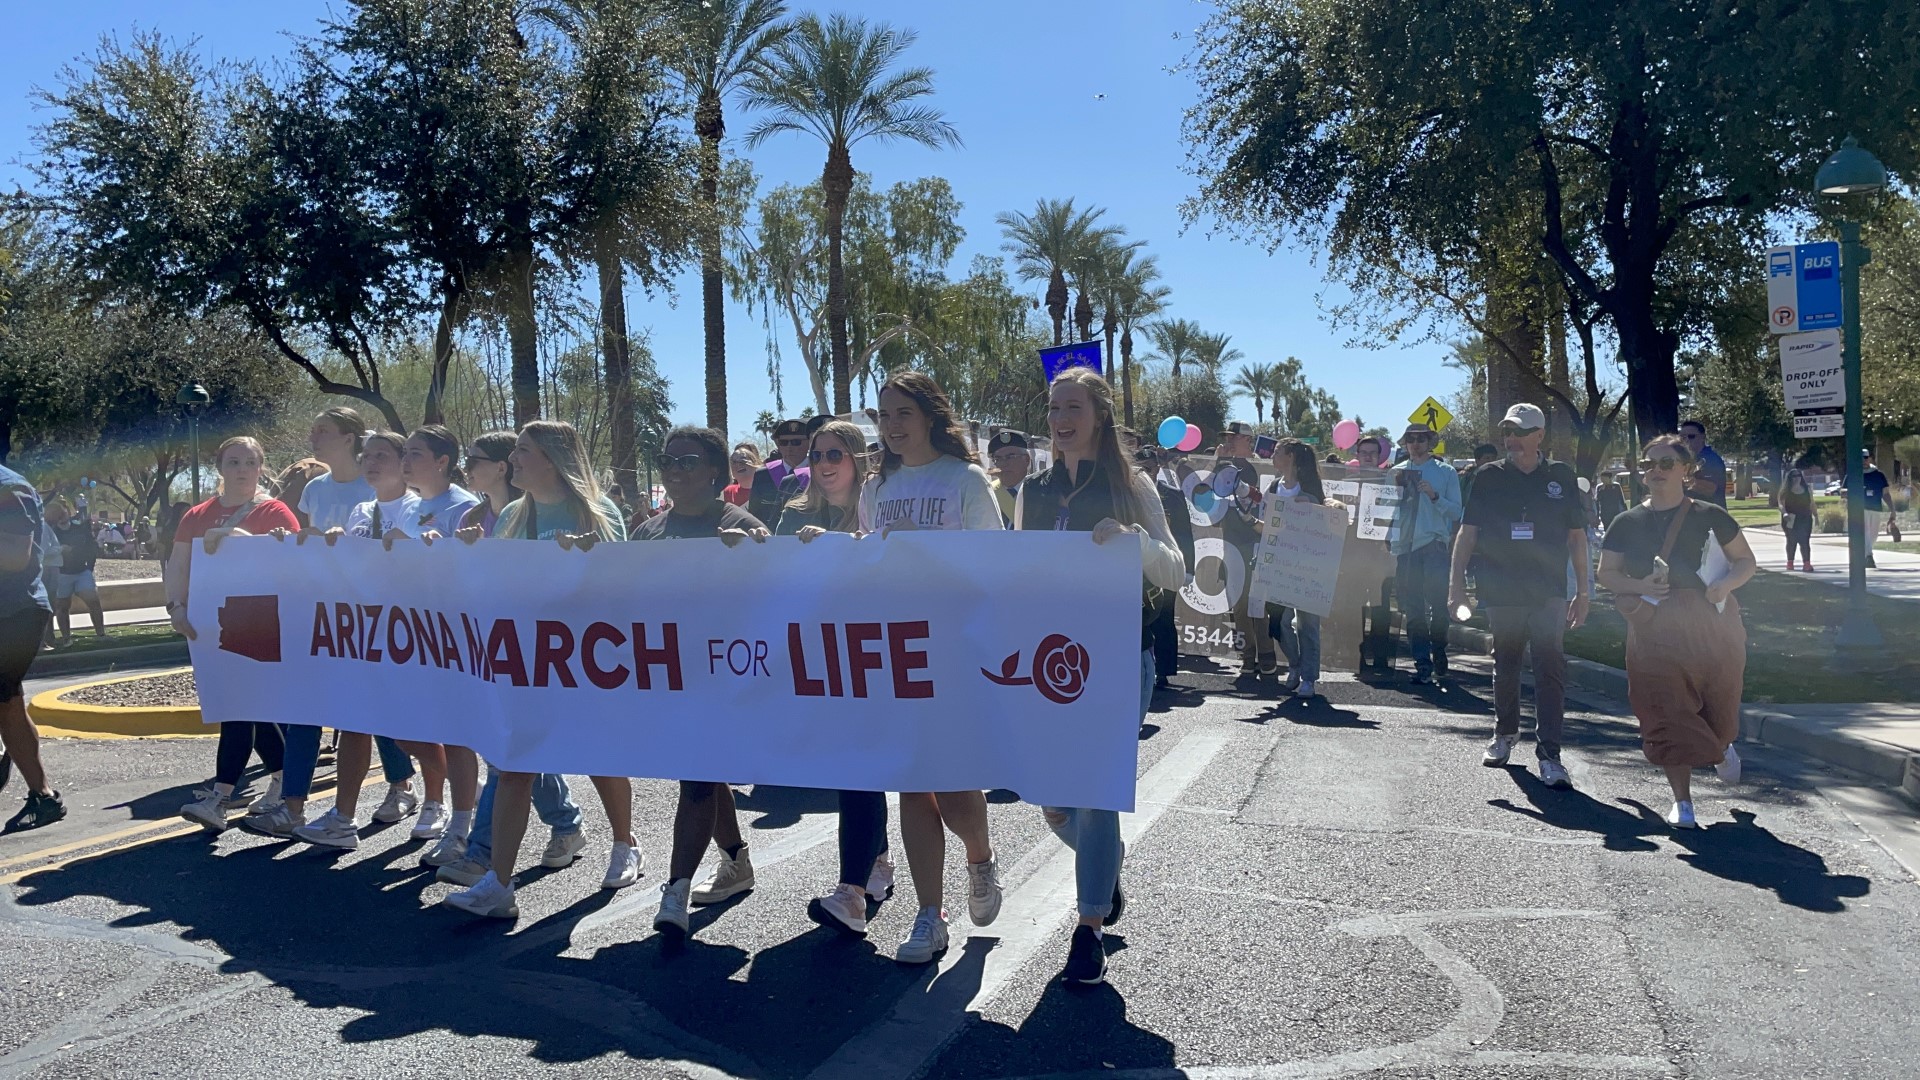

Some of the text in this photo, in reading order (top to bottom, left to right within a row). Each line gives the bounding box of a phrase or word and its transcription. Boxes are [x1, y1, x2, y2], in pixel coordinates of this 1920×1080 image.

[1804, 256, 1832, 269] BUS
[1786, 368, 1840, 382] DROP-OFF
[1800, 379, 1827, 389] ONLY
[875, 498, 917, 529] CHOOSE
[1183, 625, 1246, 650] 53445
[310, 601, 934, 699] ARIZONA MARCH FOR LIFE
